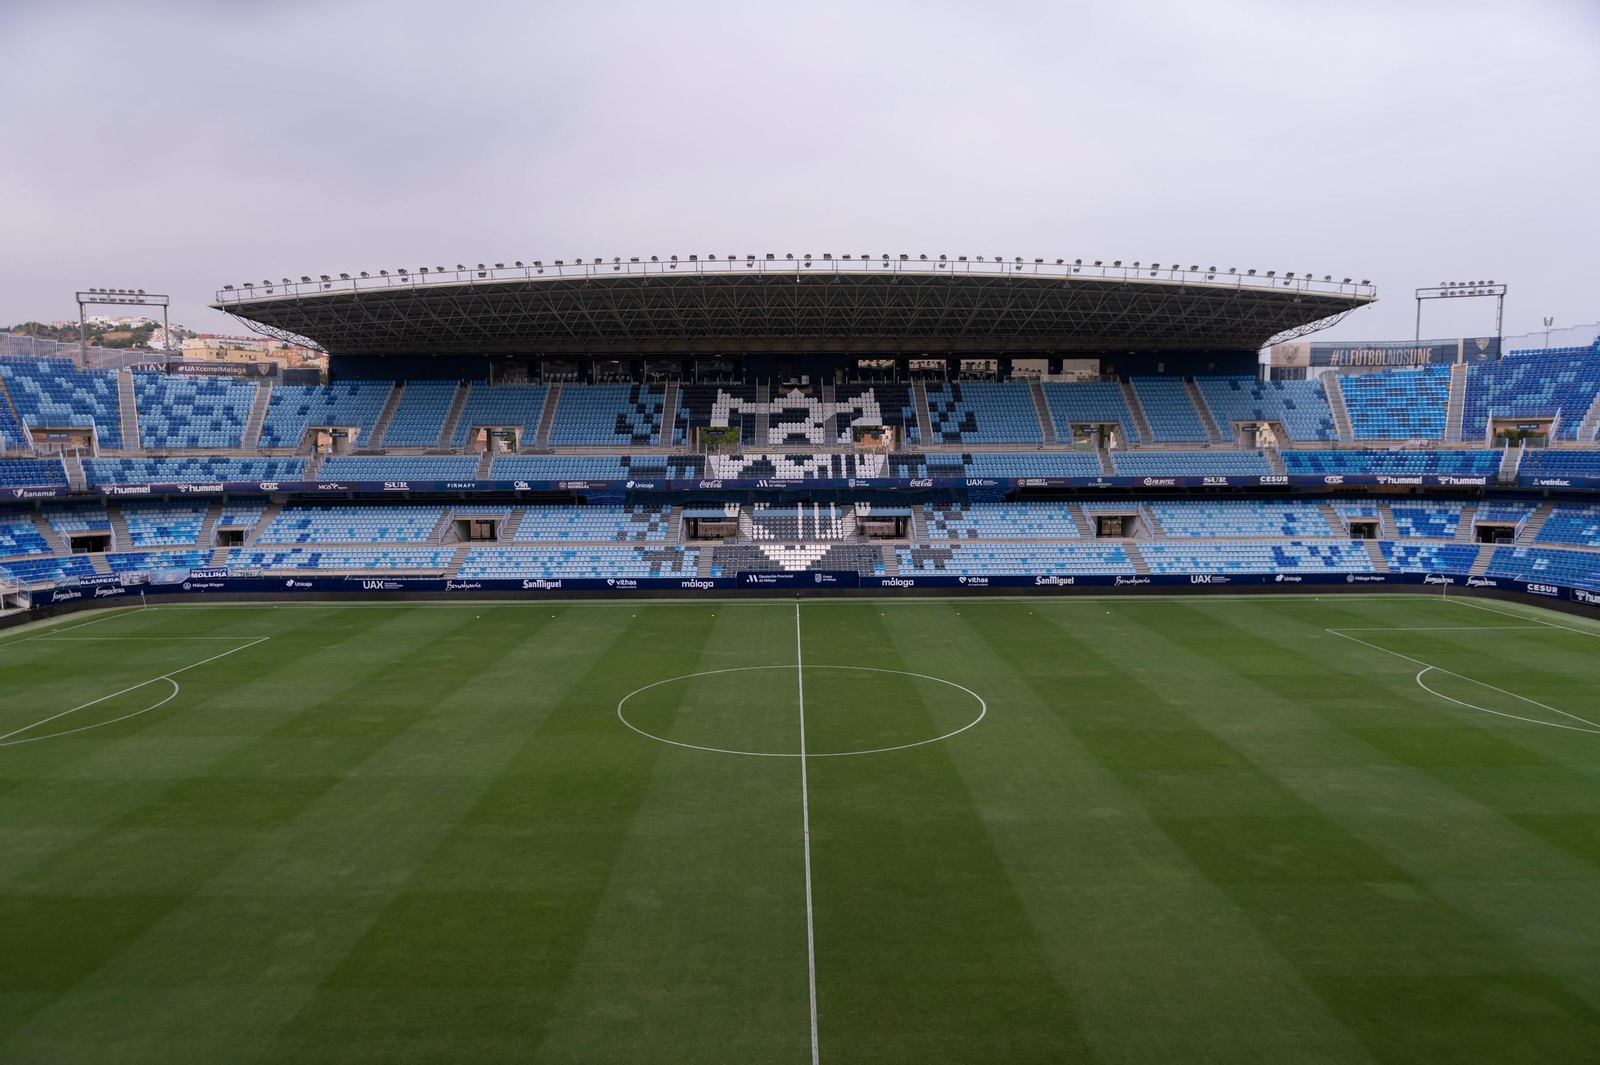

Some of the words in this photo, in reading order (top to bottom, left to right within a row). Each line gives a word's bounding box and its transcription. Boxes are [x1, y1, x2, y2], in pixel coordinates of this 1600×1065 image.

[1388, 476, 1422, 484] hummel
[1450, 476, 1486, 485] hummel
[114, 486, 150, 494] hummel
[189, 484, 223, 492] hummel
[23, 490, 56, 498] Sanamar
[80, 577, 119, 585] ALAMEDA
[1191, 574, 1211, 583] UAX
[363, 581, 383, 589] UAX
[1527, 583, 1558, 593] CESUR
